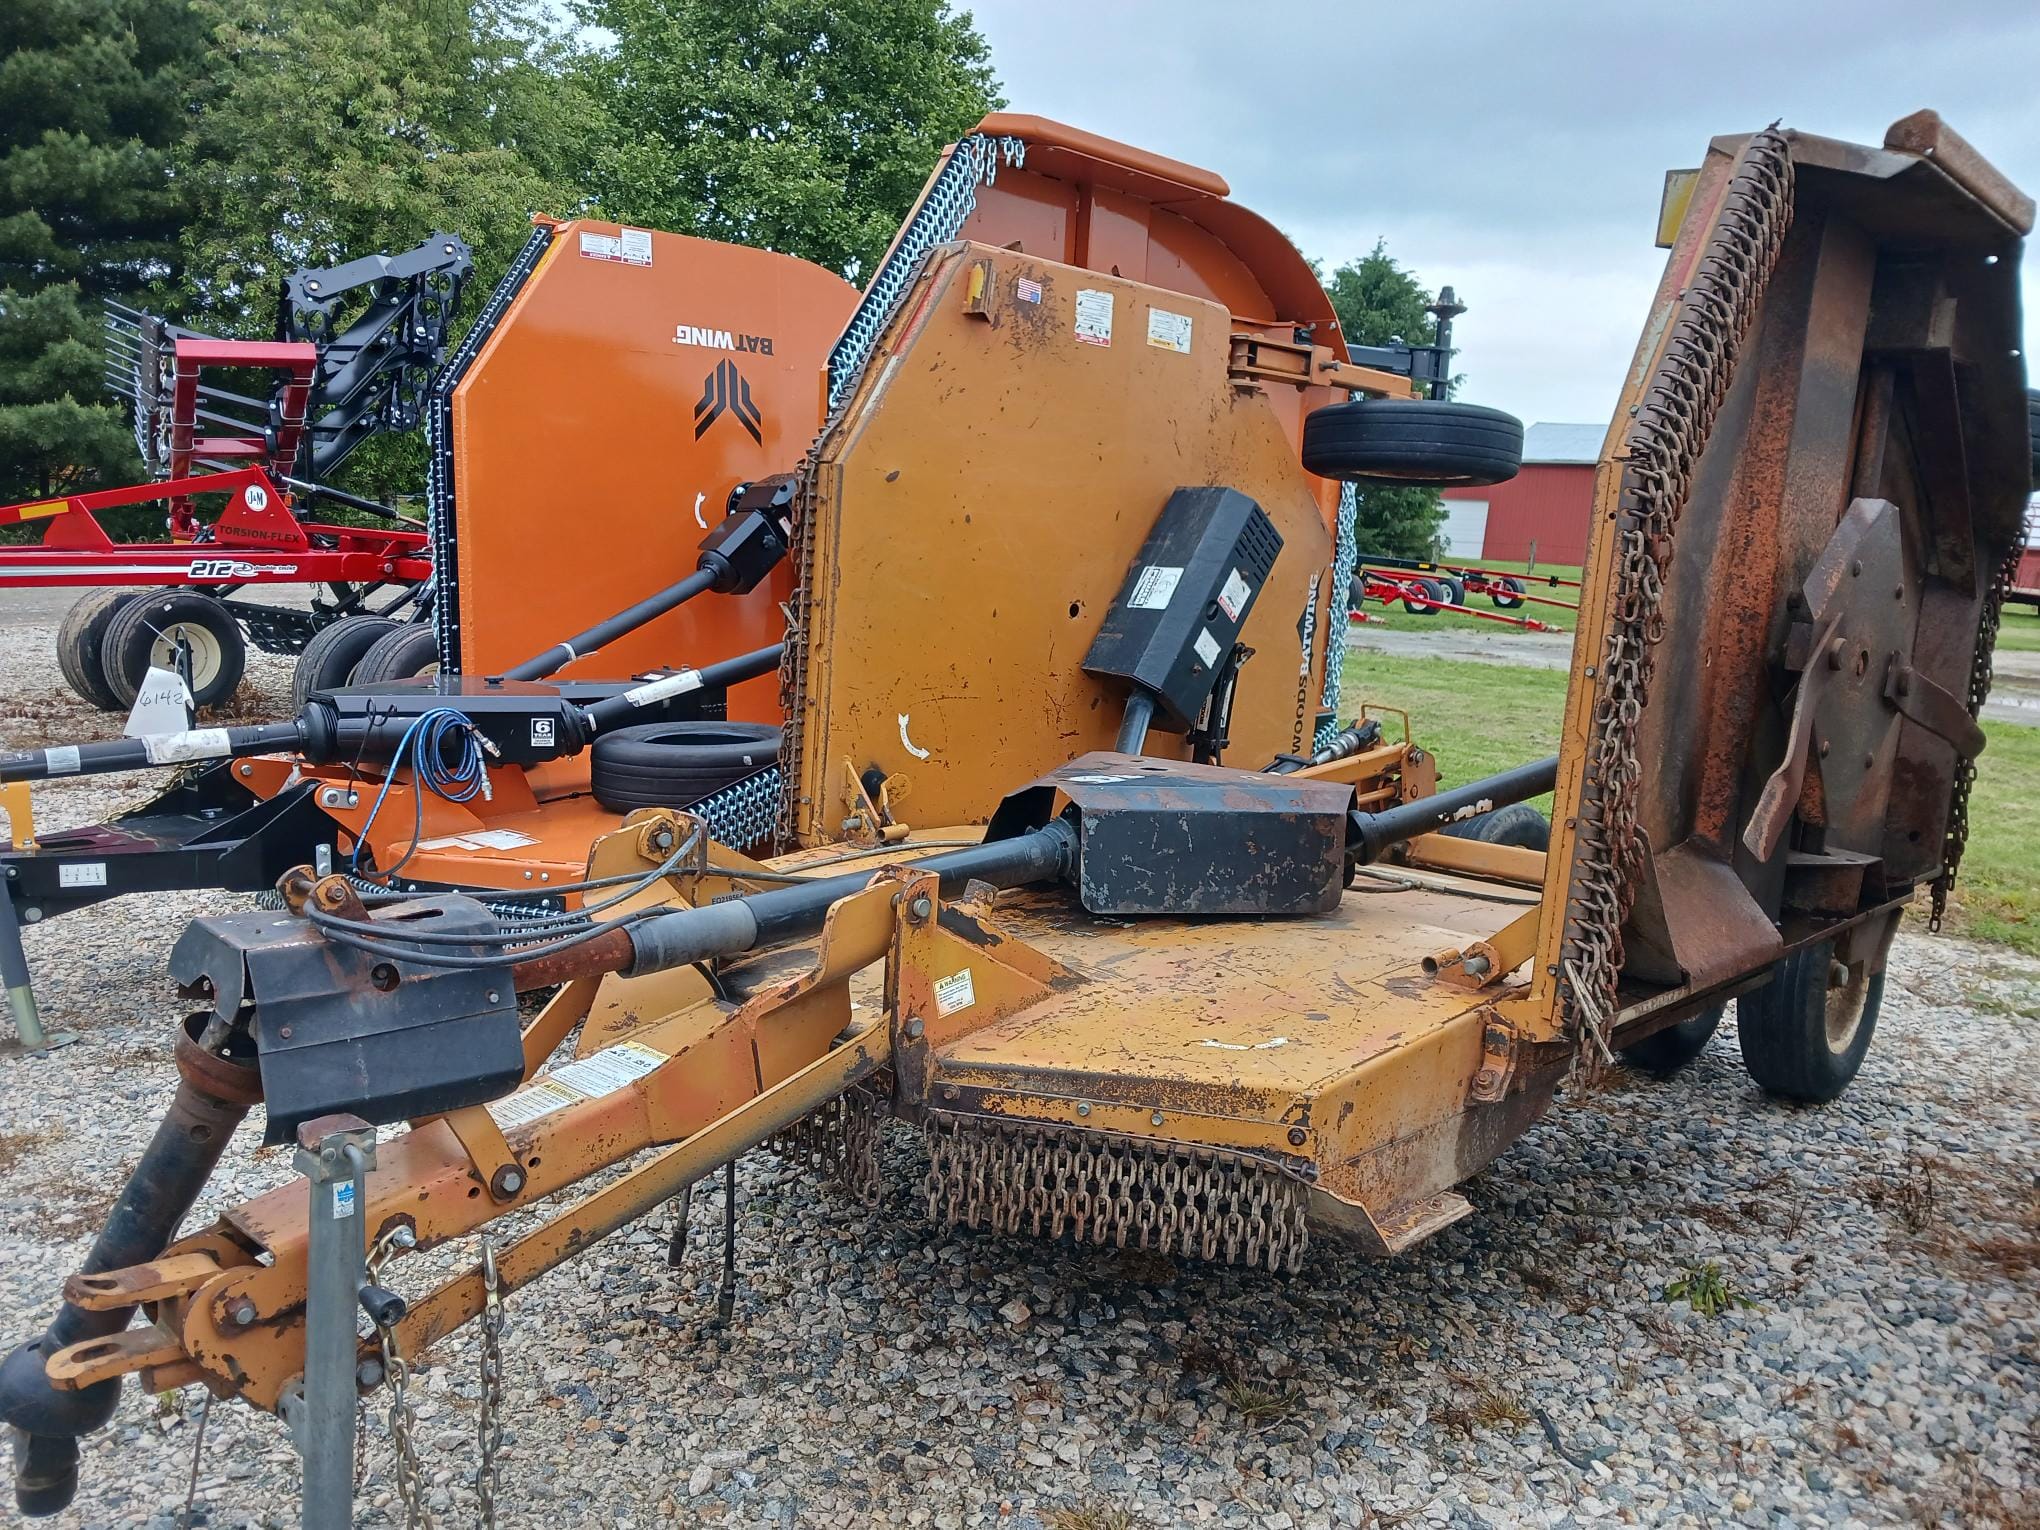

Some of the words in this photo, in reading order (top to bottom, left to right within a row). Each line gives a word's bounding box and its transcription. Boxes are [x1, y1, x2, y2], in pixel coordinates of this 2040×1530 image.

[247, 490, 264, 506] J&M
[220, 525, 299, 543] TORSION-FLEX
[190, 562, 233, 576] 212
[1291, 675, 1308, 755] WOODS
[1300, 573, 1319, 676] BATWING
[535, 720, 551, 733] 6
